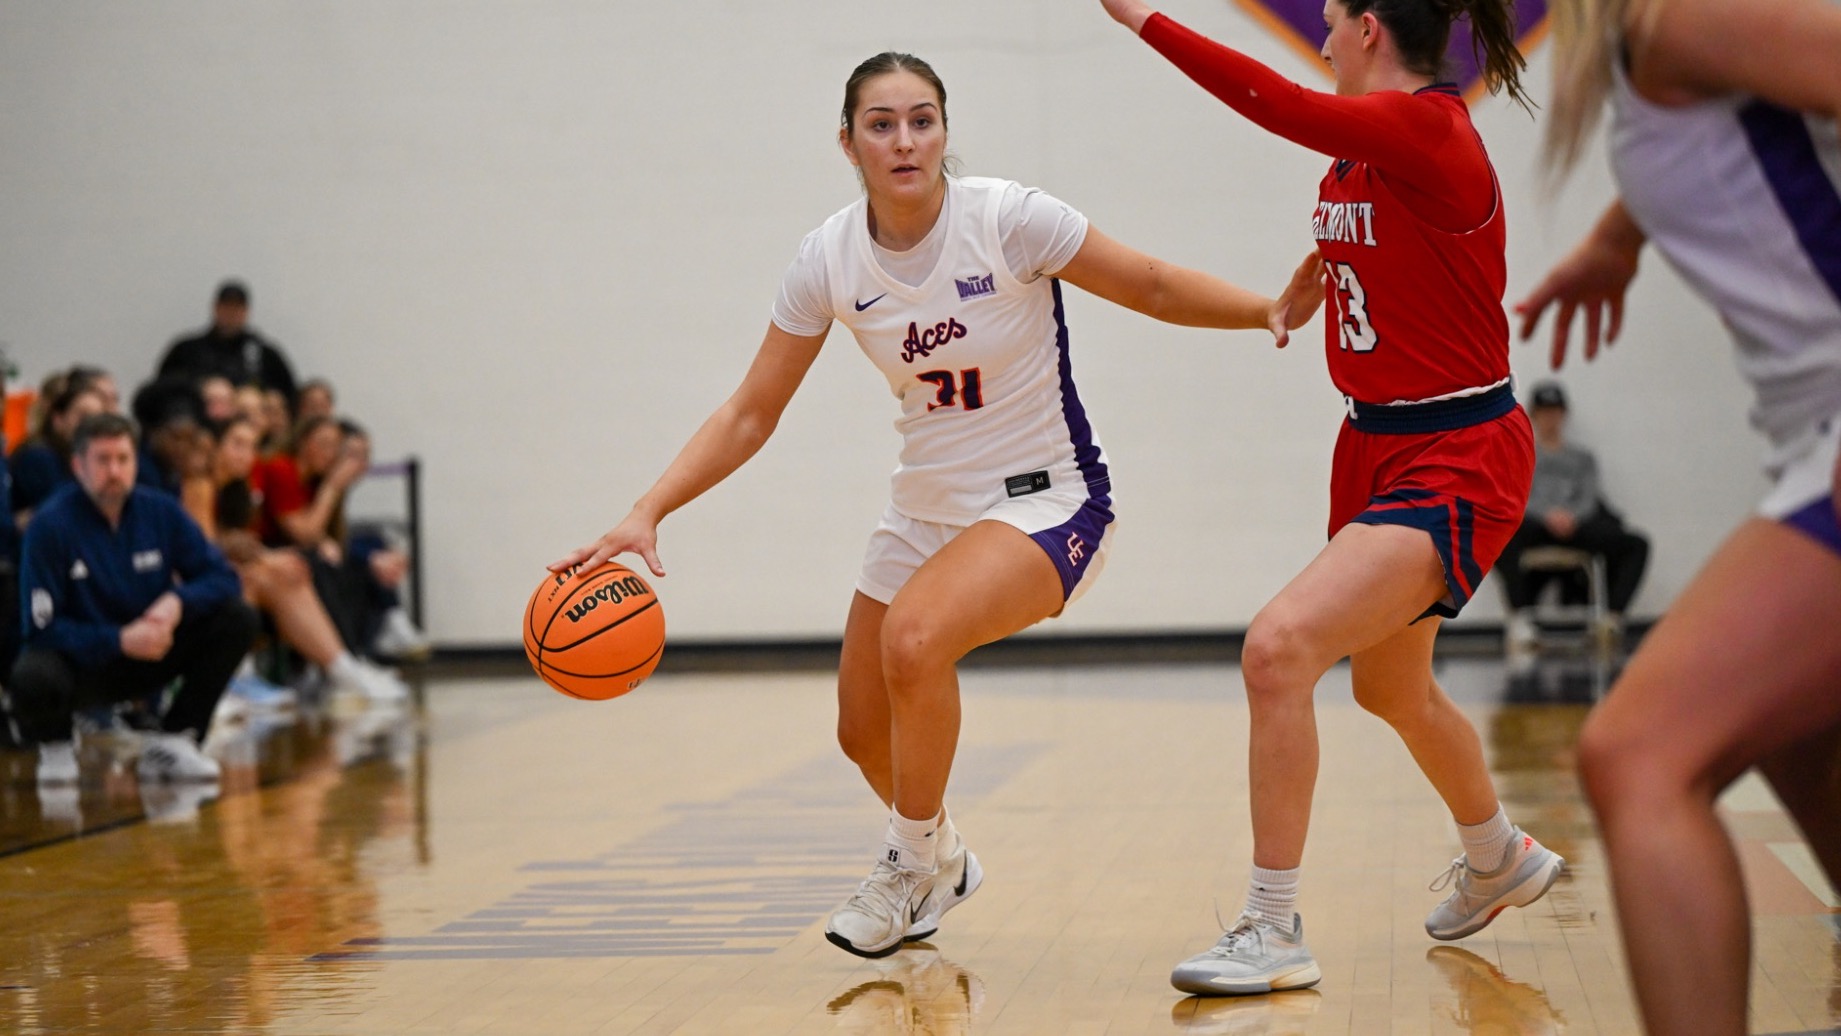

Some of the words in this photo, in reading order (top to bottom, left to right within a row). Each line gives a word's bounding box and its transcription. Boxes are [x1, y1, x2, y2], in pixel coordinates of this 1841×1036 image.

[954, 272, 996, 299] VALLEY
[915, 367, 984, 412] 31
[1035, 476, 1044, 486] M
[1066, 531, 1085, 567] UE
[565, 575, 650, 623] Wilson
